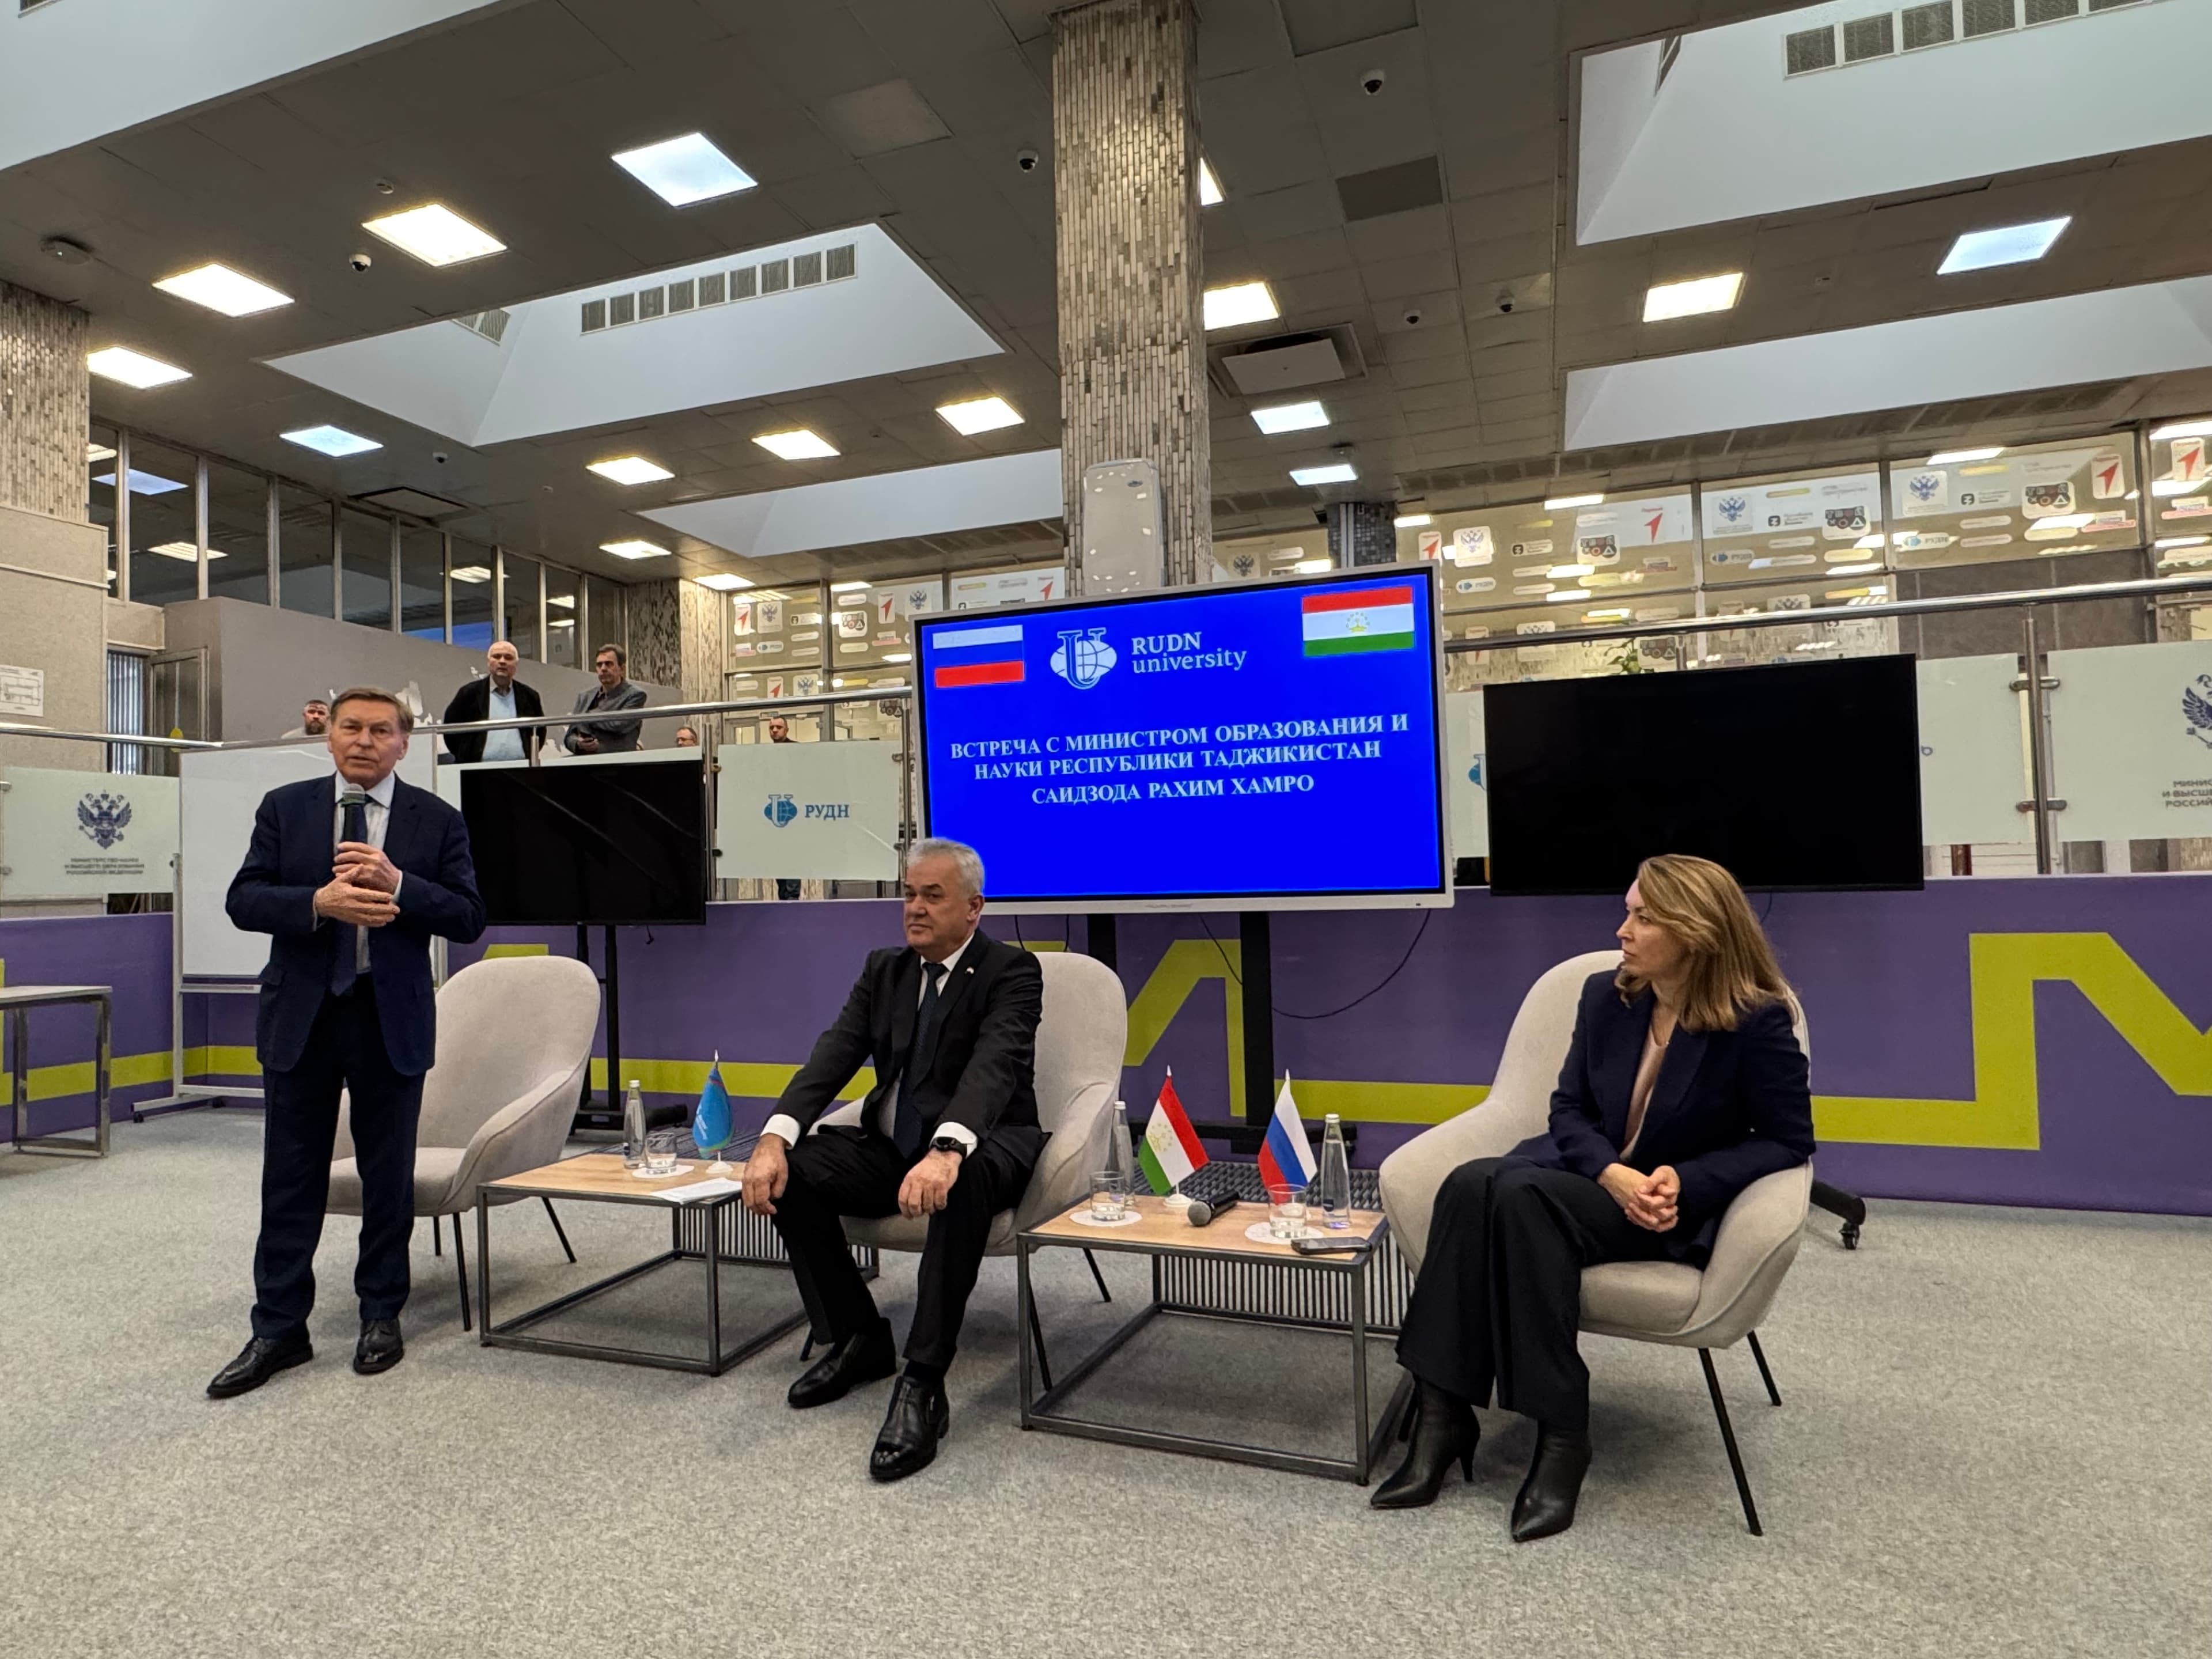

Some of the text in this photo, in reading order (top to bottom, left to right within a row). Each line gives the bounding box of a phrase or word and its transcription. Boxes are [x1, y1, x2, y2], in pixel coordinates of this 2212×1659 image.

[1131, 632, 1202, 655] RUDN
[1132, 647, 1247, 673] university
[951, 714, 1409, 759] ВСТРЕЧА С МИНИСТРОМ ОБРАЗОВАНИЯ И
[975, 740, 1381, 780] НАУКИ РЕСПУБЛИКИ ТАДЖИКИСТАН
[1032, 775, 1315, 805] САИДЗОДА РАХИМ ХАМРО
[805, 805, 850, 820] РУДН
